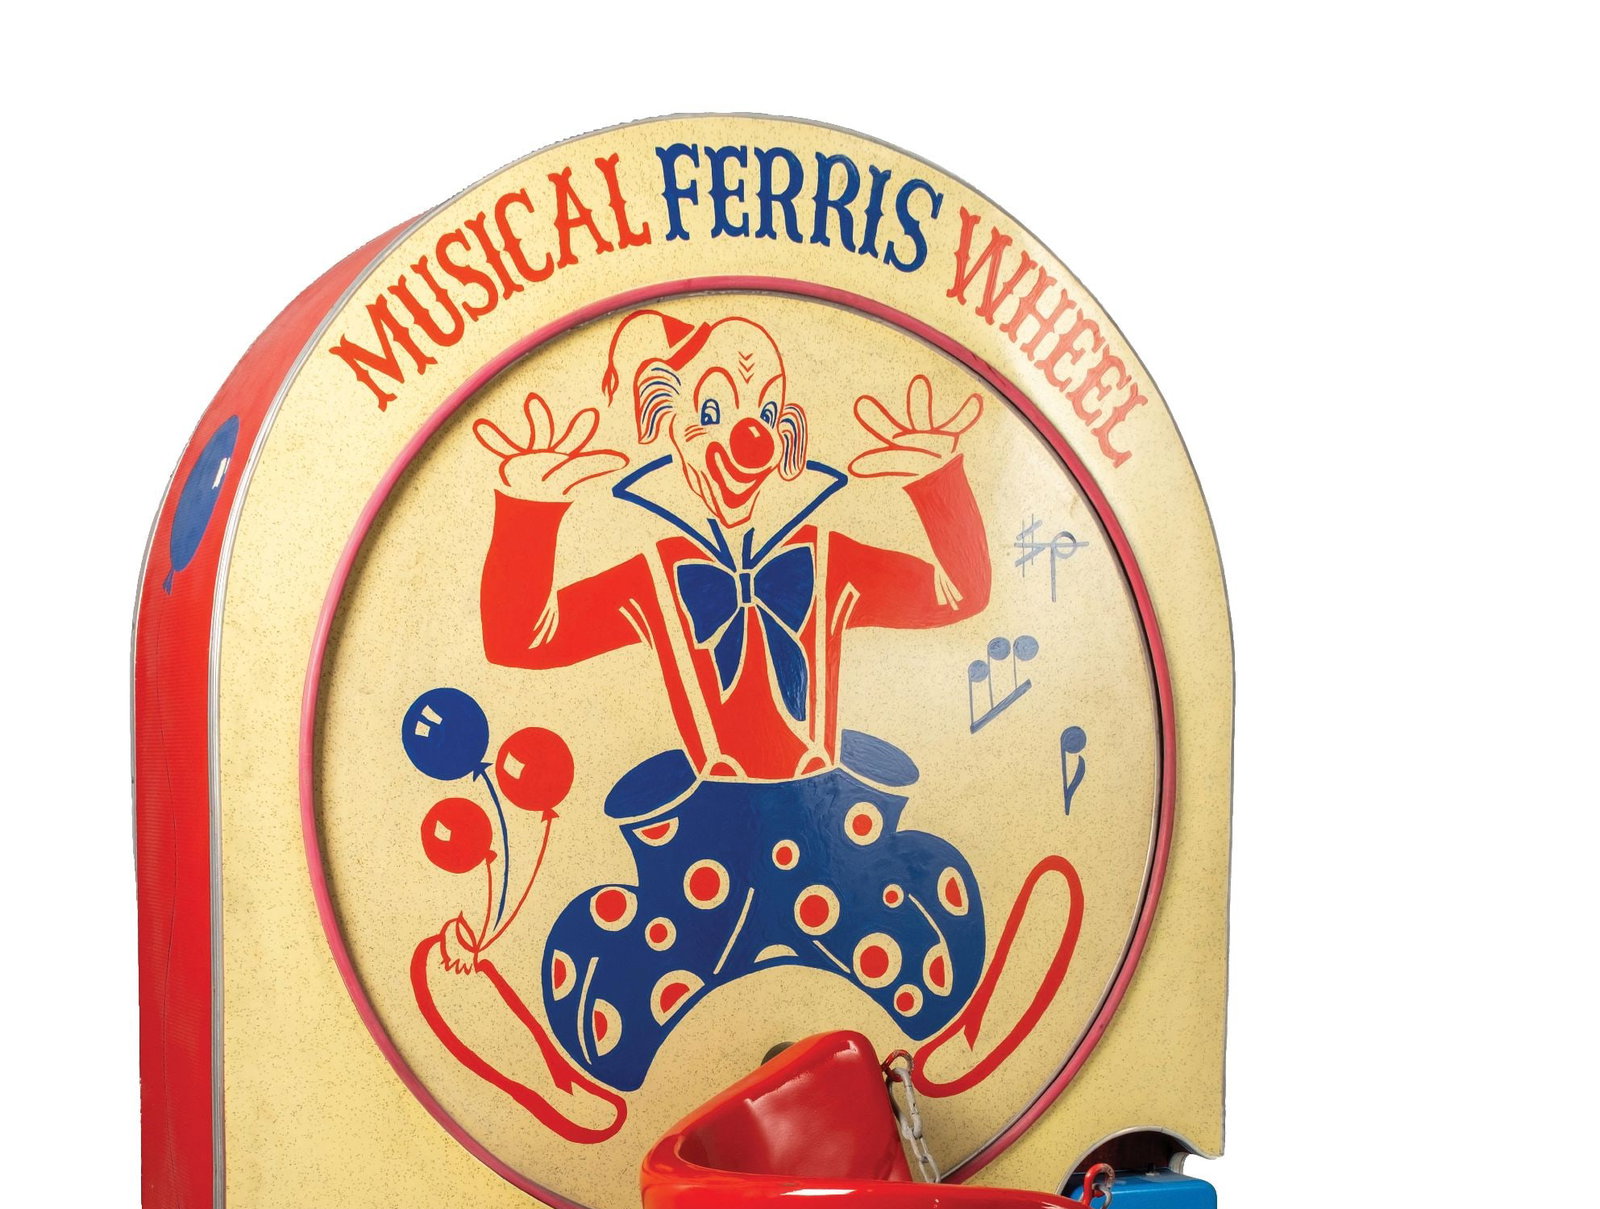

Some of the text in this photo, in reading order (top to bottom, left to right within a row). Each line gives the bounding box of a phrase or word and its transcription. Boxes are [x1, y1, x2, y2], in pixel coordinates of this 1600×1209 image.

[329, 144, 1148, 468] MUSICAL FERRIS WHEEL
